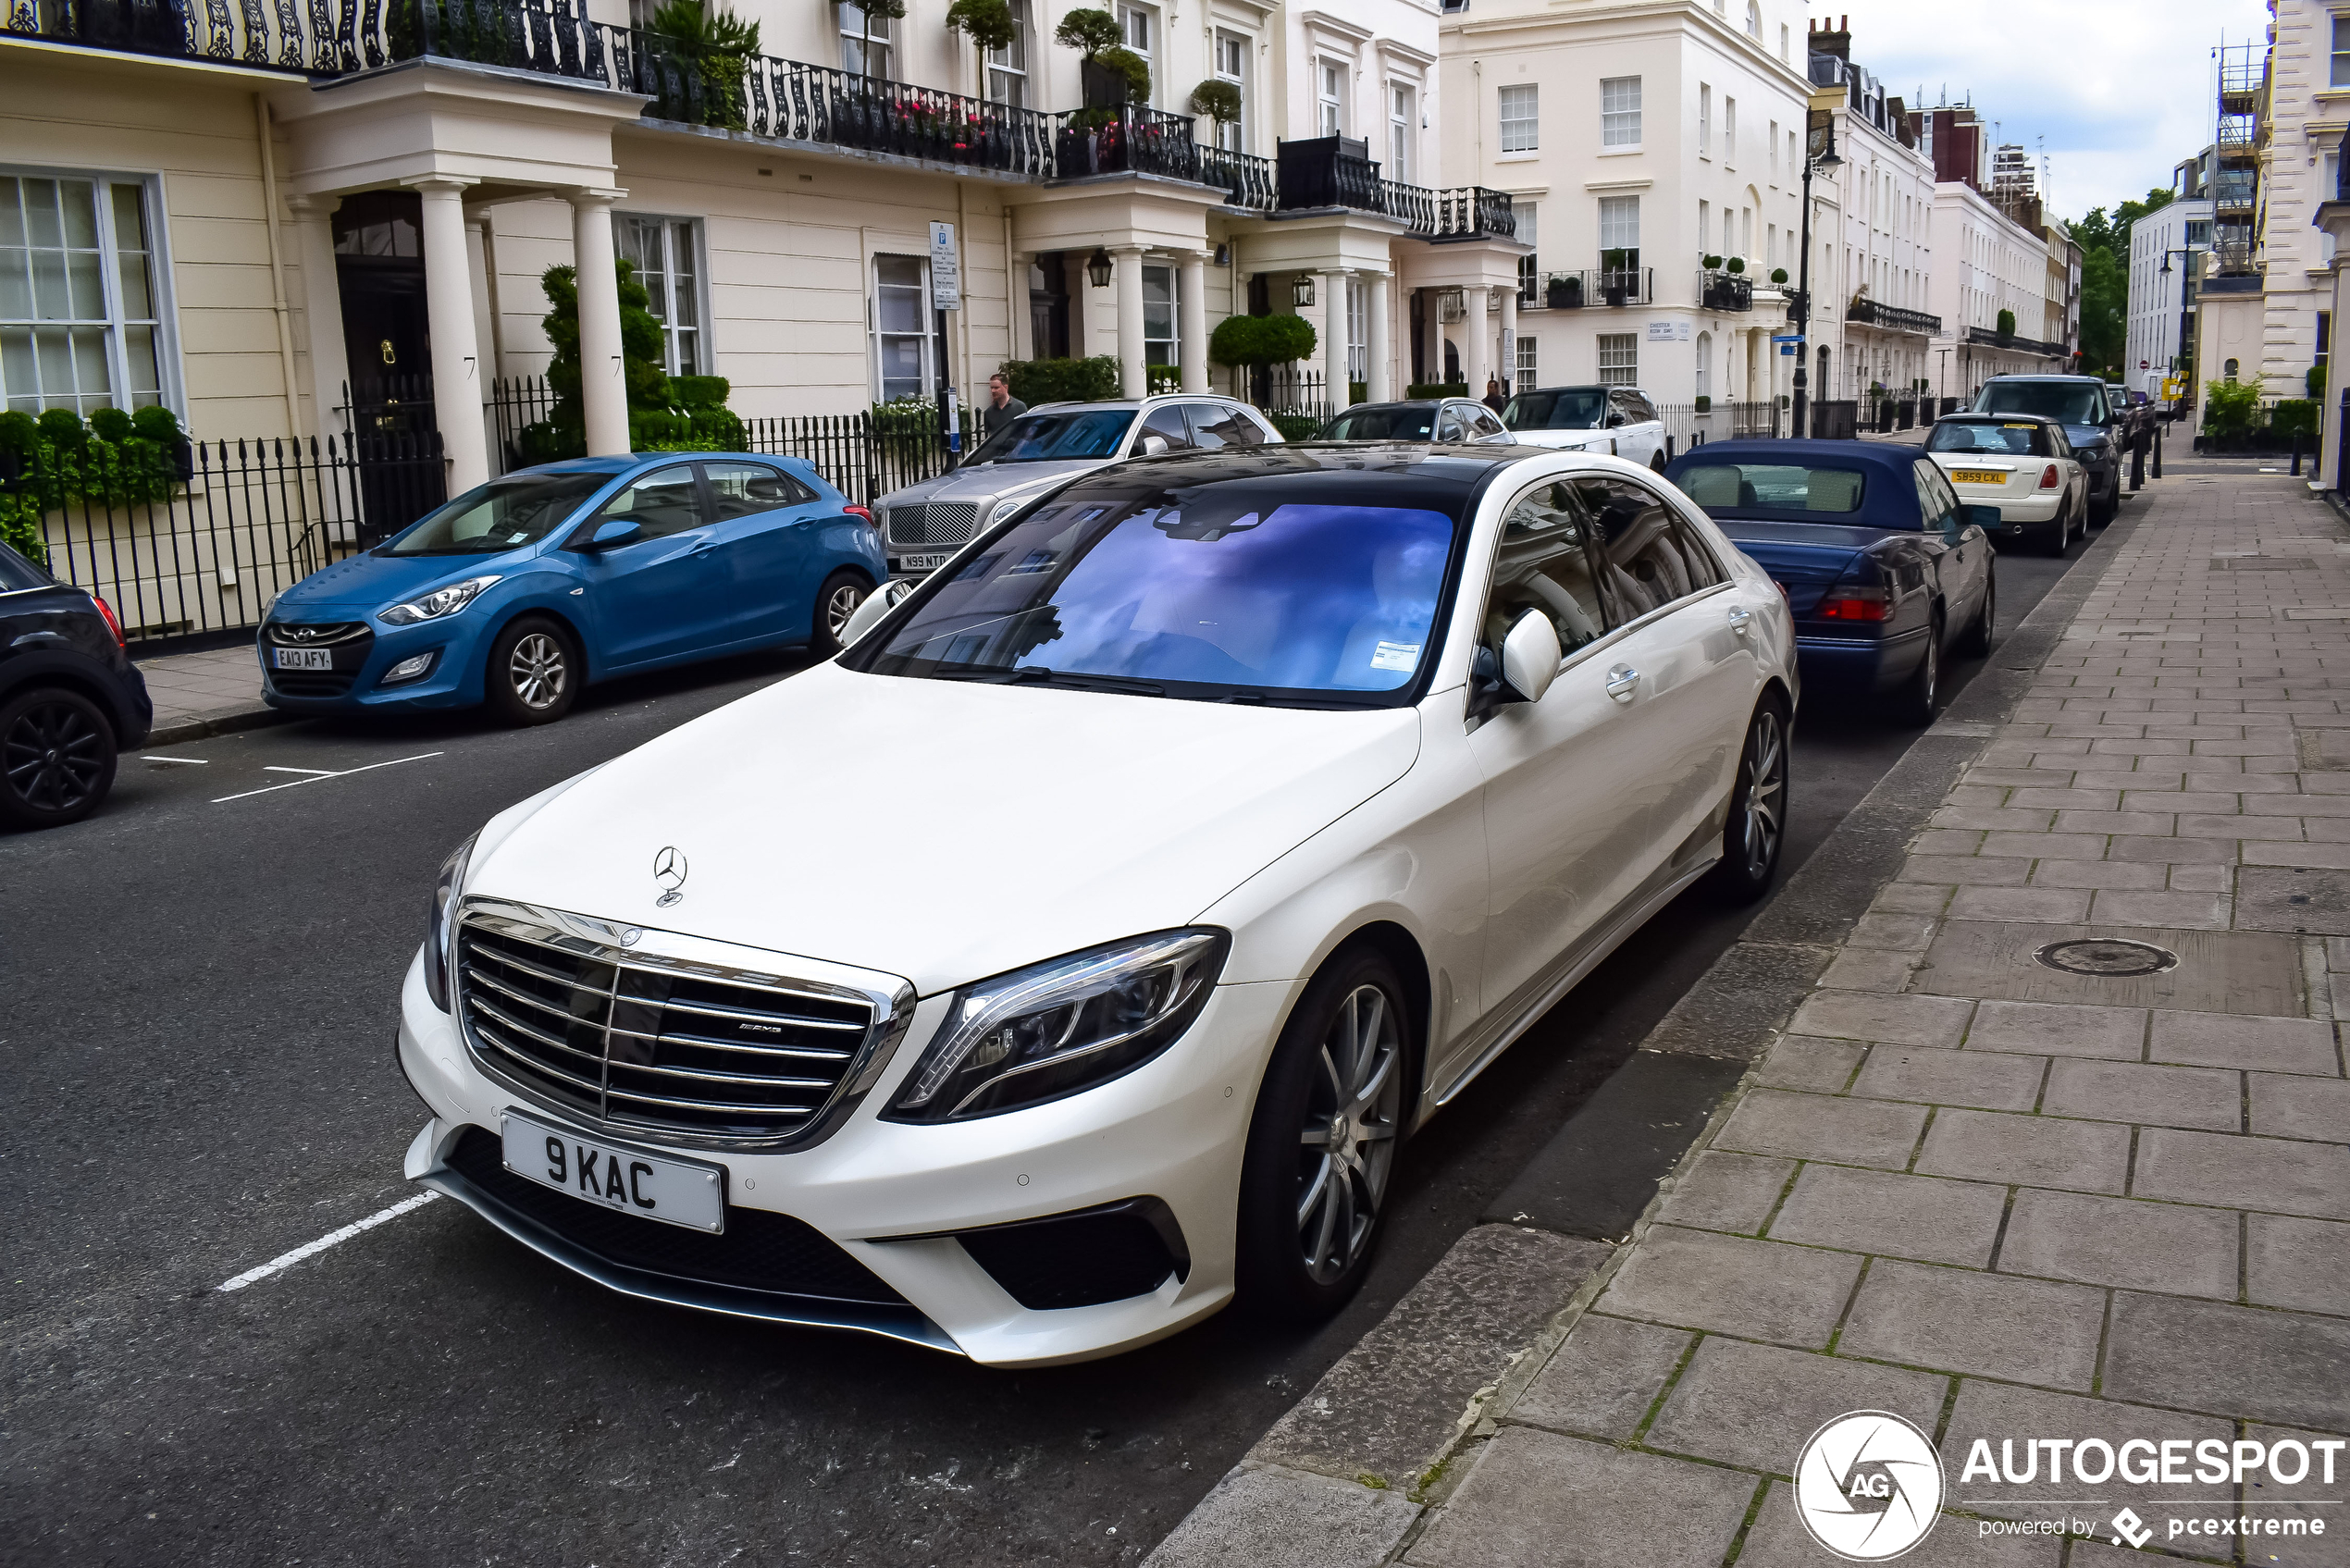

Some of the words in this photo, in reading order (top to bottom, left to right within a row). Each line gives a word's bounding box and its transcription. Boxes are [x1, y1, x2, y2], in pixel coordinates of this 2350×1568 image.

[464, 356, 476, 380] 7
[612, 355, 621, 377] 7
[1956, 472, 1981, 482] SB59
[1984, 473, 2002, 483] CXL
[907, 555, 923, 567] N99
[279, 650, 302, 666] EA13
[304, 651, 326, 667] AFY
[545, 1136, 567, 1184] 9
[576, 1145, 656, 1210] KAC
